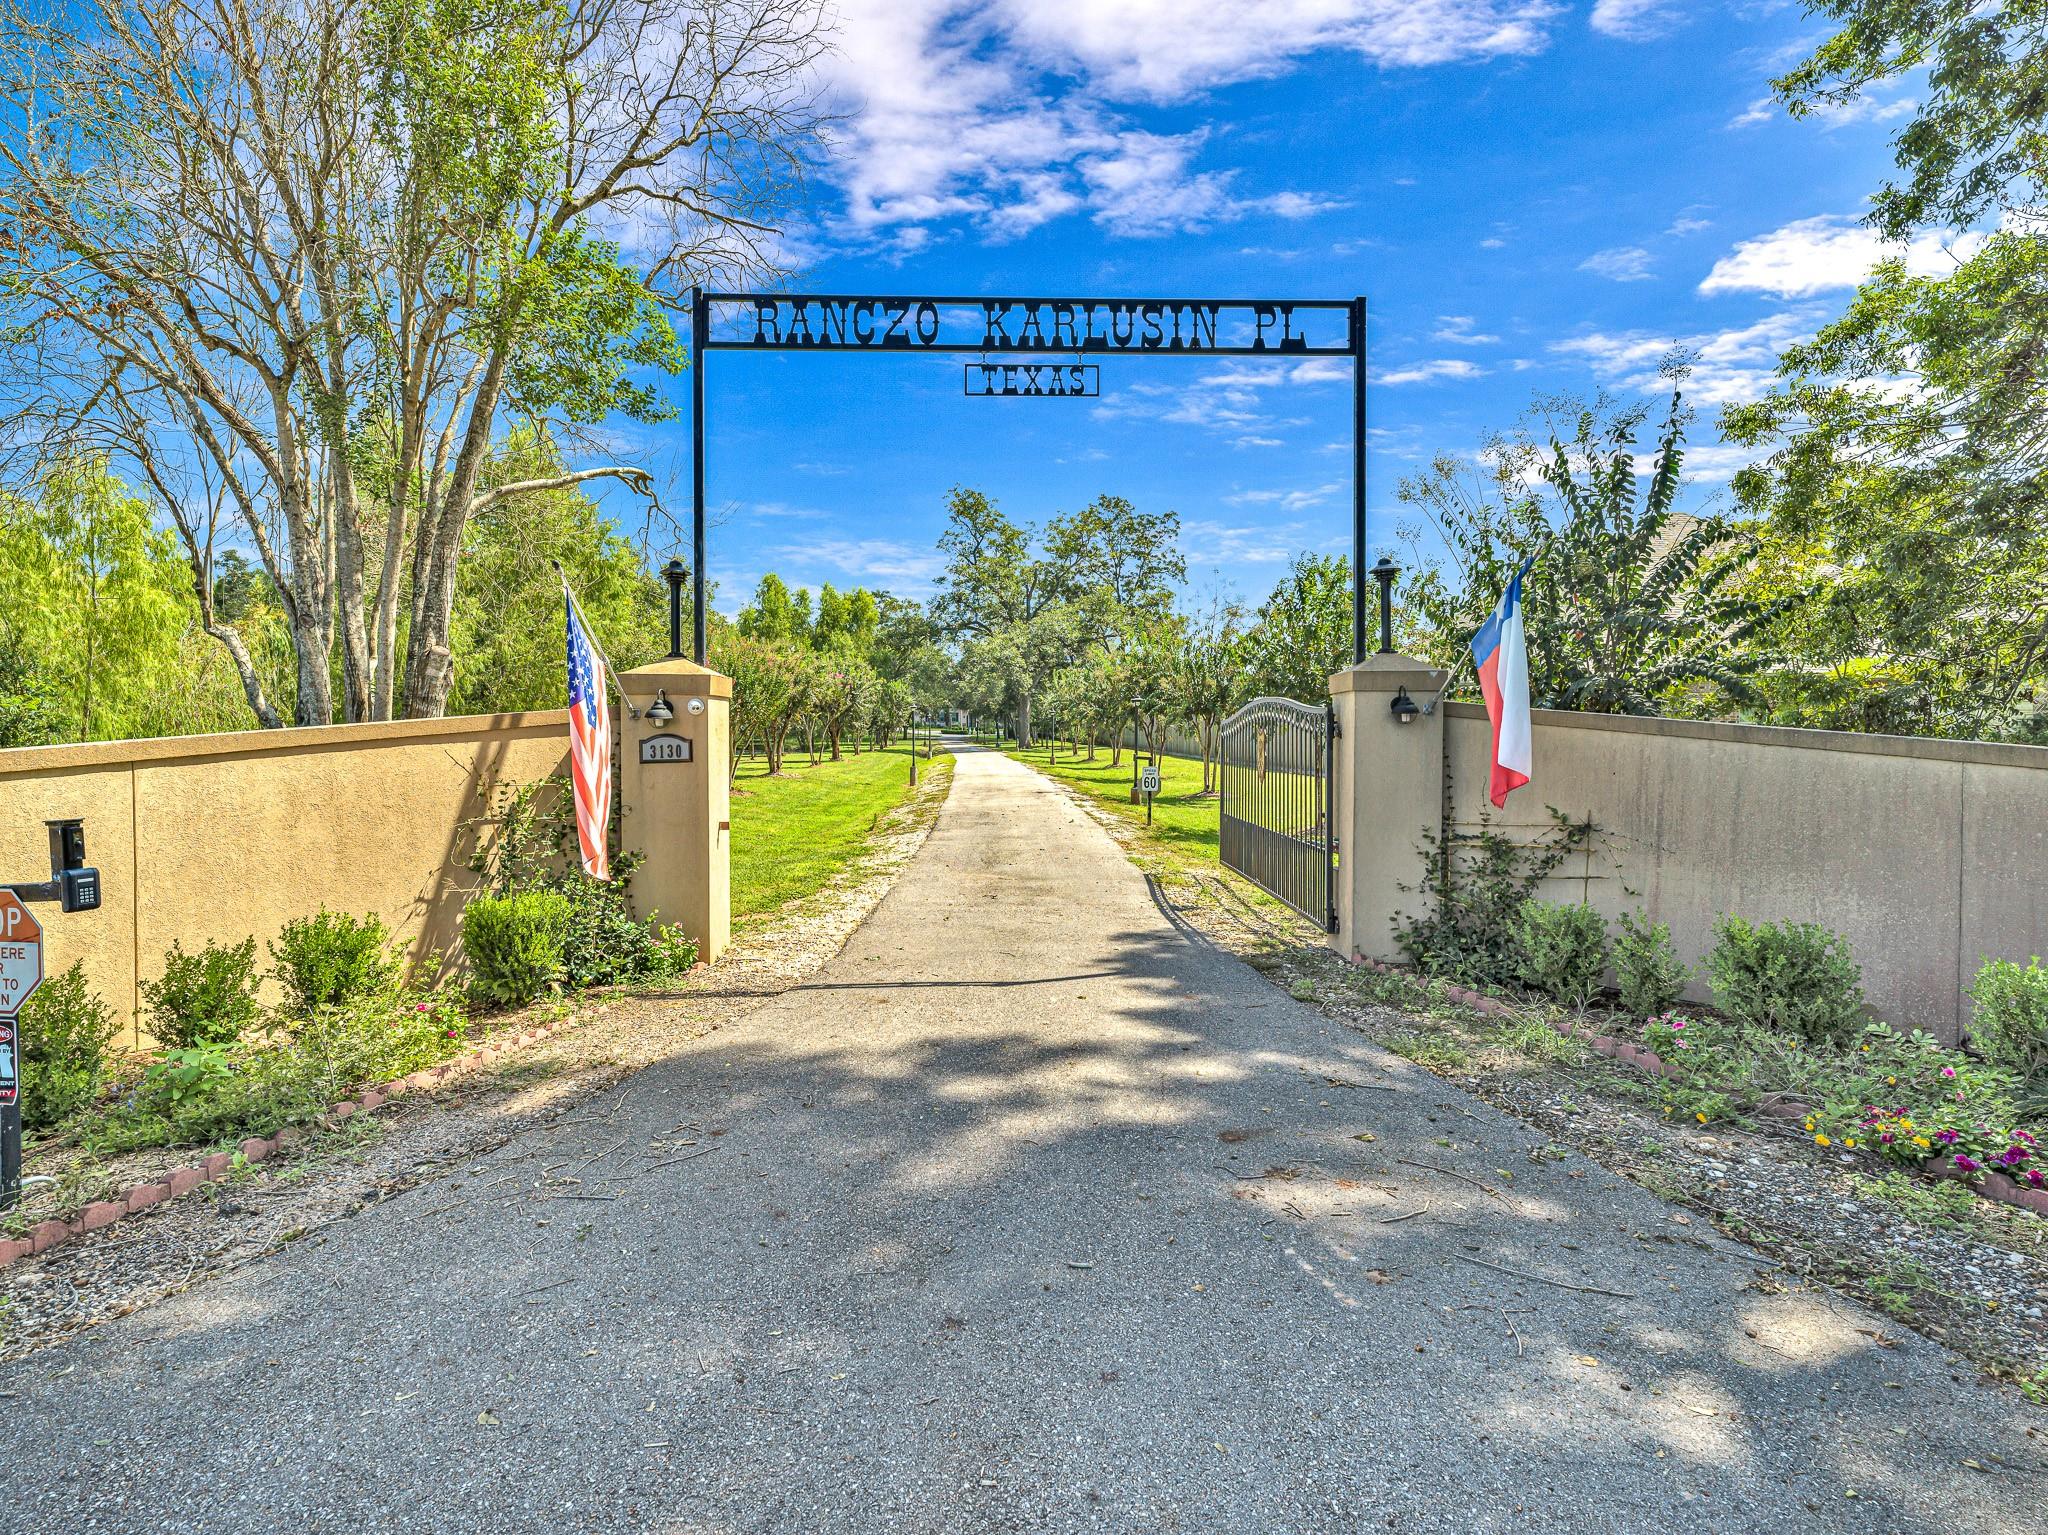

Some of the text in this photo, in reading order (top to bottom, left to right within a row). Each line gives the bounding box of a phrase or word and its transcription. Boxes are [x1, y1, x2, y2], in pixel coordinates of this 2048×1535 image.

[753, 299, 1308, 351] RANCZO KARLUSIN PL
[979, 364, 1086, 395] TEXAS
[650, 744, 682, 758] 3130
[1144, 776, 1156, 788] 60
[2, 978, 19, 991] TO
